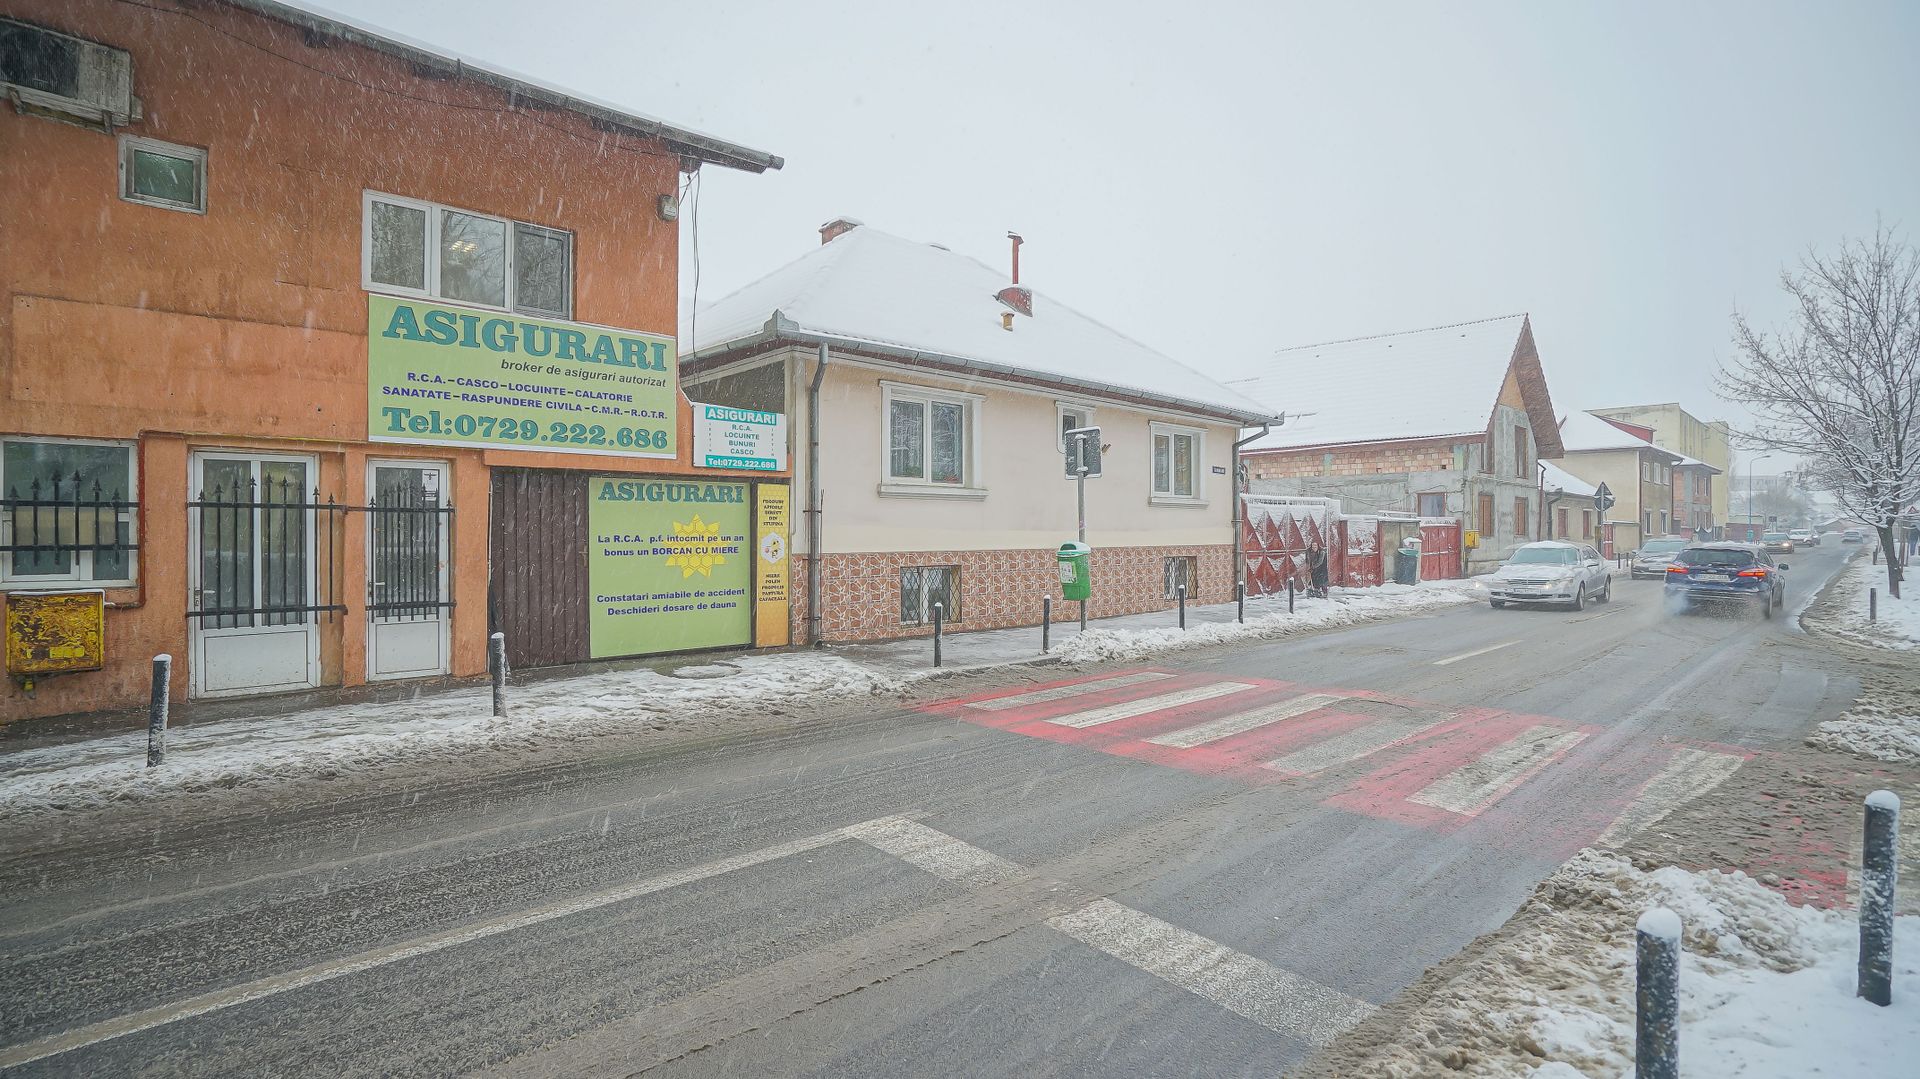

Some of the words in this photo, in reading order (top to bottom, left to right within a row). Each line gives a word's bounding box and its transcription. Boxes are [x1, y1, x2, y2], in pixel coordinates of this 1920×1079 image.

[382, 305, 667, 372] ASIGURARI
[501, 359, 543, 374] broker
[546, 364, 561, 376] de
[564, 367, 616, 383] asigurari
[619, 374, 667, 388] autorizat
[707, 407, 776, 425] ASIGURARI
[382, 406, 668, 450] Tel:0729.222.686
[724, 432, 760, 440] LOCUINTE
[729, 440, 756, 448] BUNURI
[730, 448, 754, 456] CASCO
[598, 481, 744, 503] ASIGURARI
[598, 535, 610, 543] La
[613, 535, 644, 543] R.C.A.
[649, 535, 664, 545] p.f.
[667, 534, 705, 543] intocmit
[707, 535, 718, 545] pe
[604, 548, 634, 556] bonus
[652, 547, 692, 555] BORCAN
[712, 546, 739, 554] MIERE
[597, 592, 649, 603] Constatari
[652, 590, 691, 600] amiabile
[694, 589, 705, 598] de
[708, 588, 745, 598] accident
[607, 605, 660, 616] Deschideri
[662, 603, 694, 613] dosare
[697, 602, 708, 610] de
[710, 601, 737, 609] dauna
